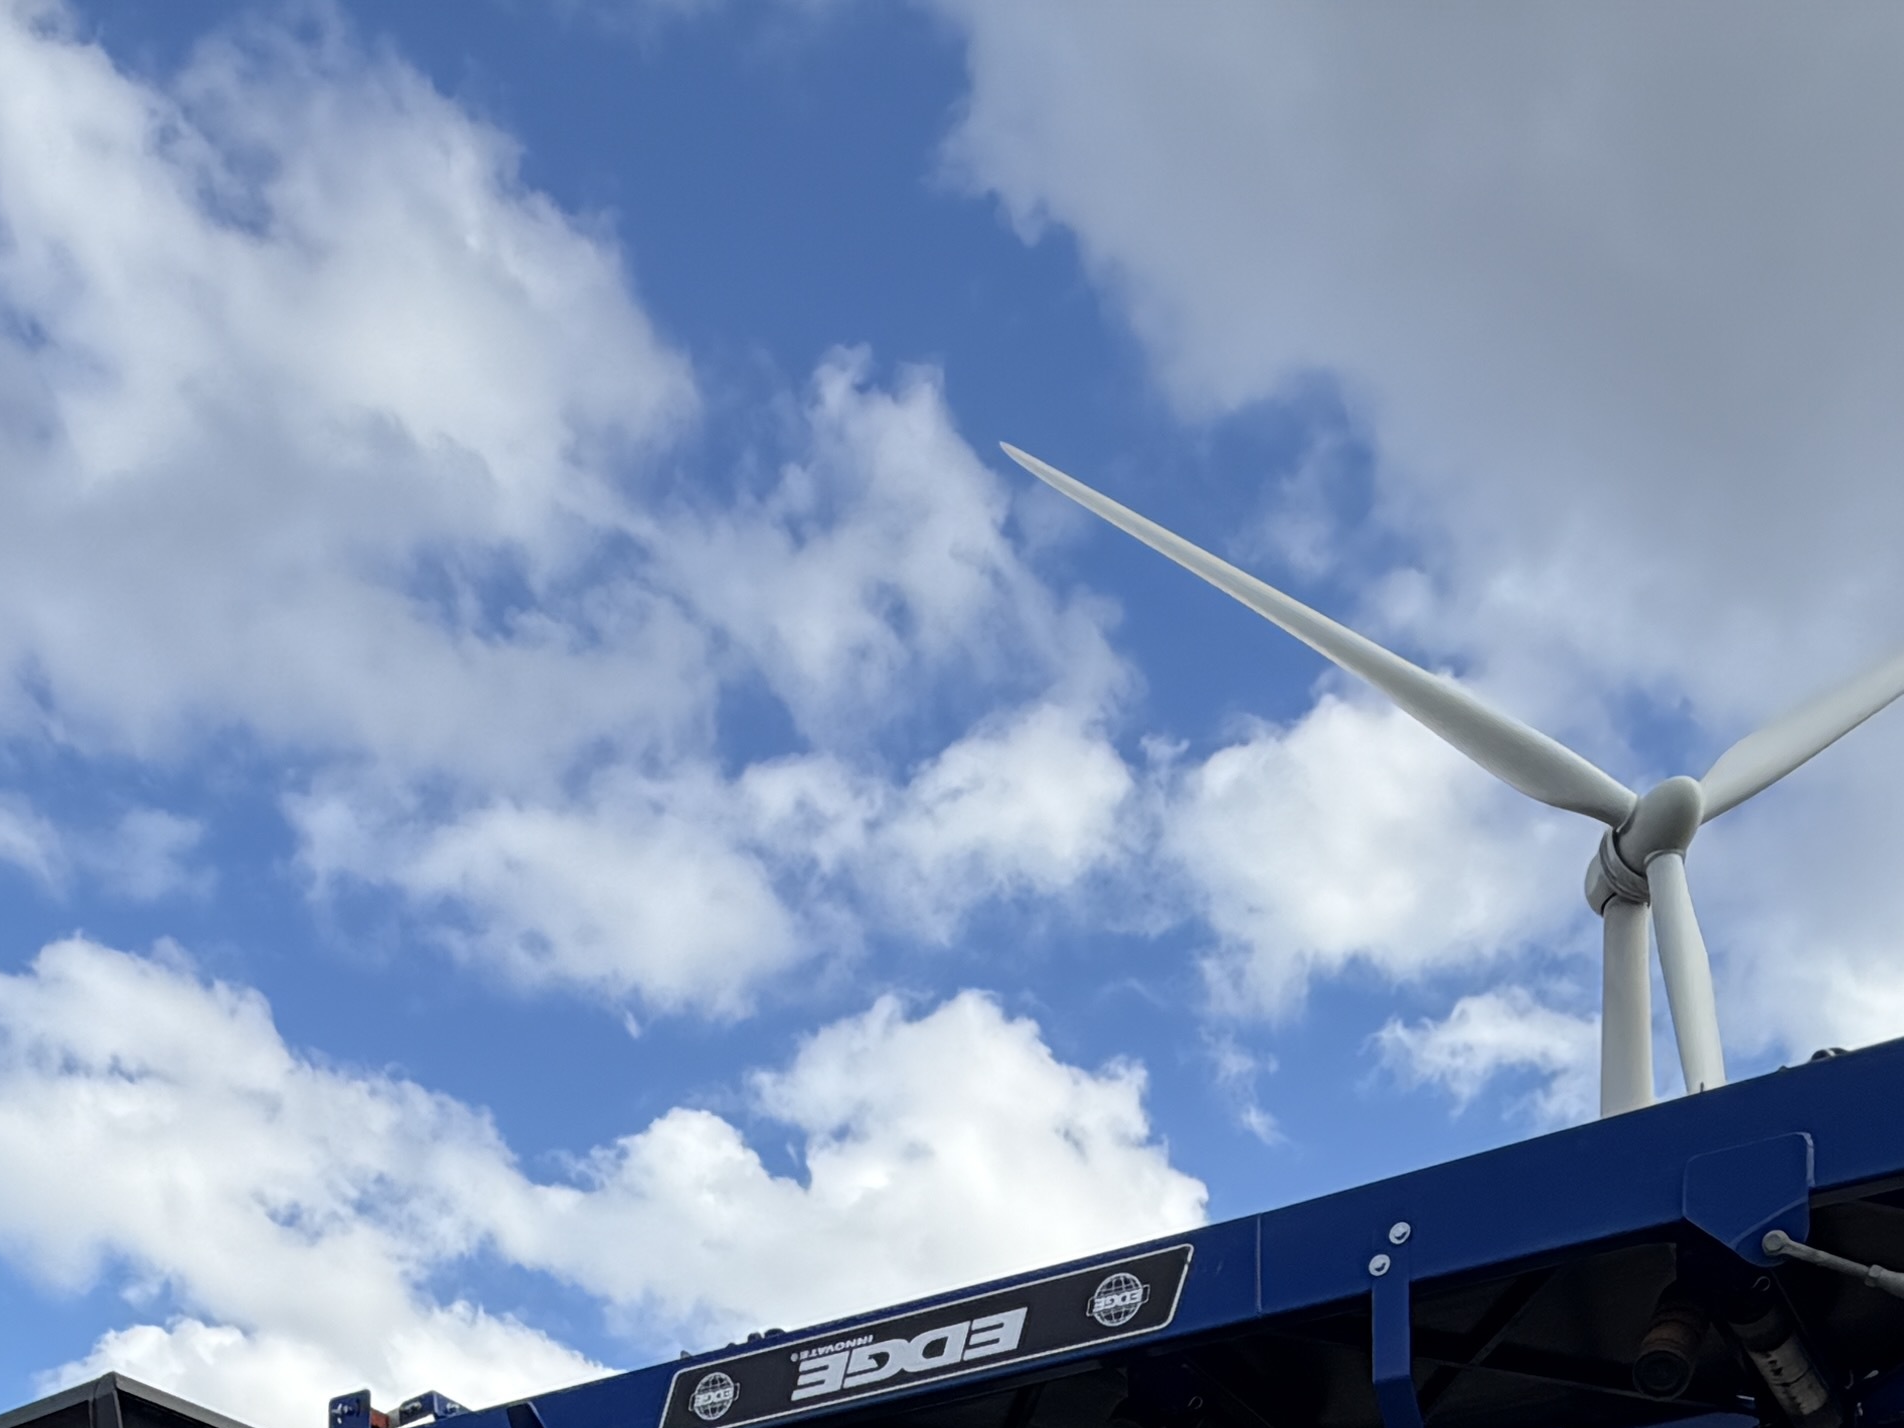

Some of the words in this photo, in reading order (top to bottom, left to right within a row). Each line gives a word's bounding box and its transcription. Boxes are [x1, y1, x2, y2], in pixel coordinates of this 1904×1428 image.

[1092, 1288, 1143, 1313] EDGE
[790, 1306, 1029, 1402] EDGE
[798, 1333, 875, 1361] INNOVATE
[693, 1386, 733, 1408] EDGE
